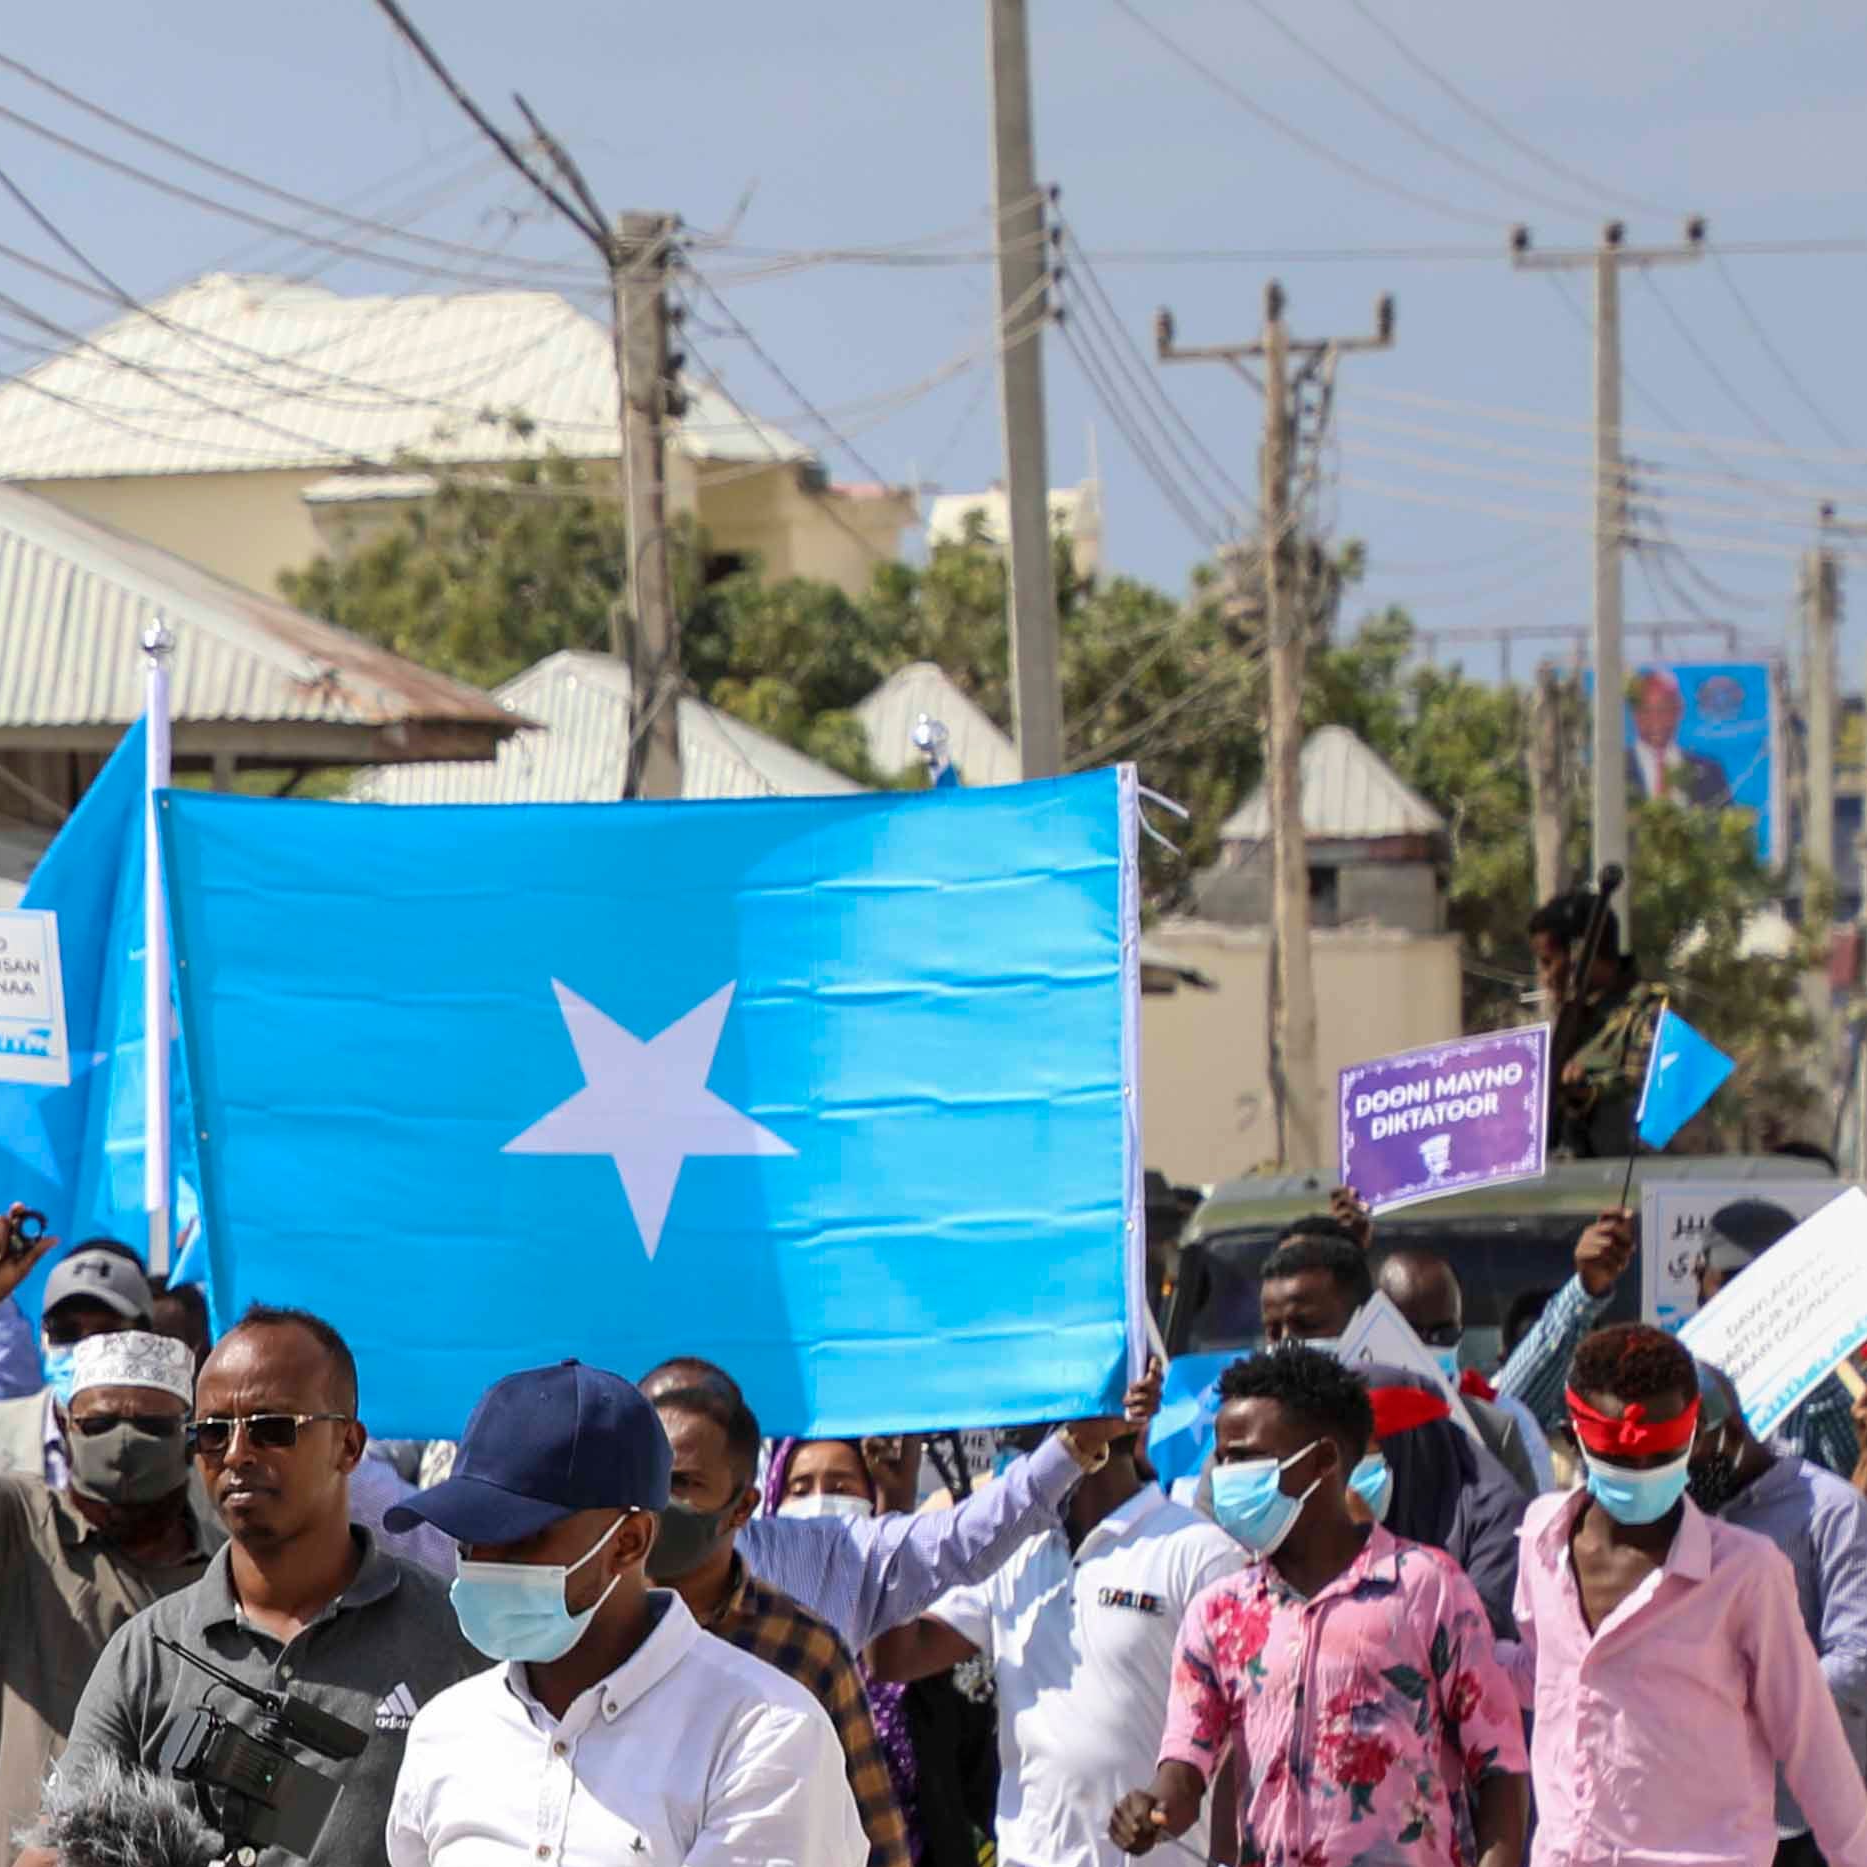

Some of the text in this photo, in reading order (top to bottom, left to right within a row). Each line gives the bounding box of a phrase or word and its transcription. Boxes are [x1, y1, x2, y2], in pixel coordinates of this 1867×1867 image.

[1355, 1061, 1524, 1119] DOONI MAYNO
[1371, 1091, 1500, 1141] DIKTATOOR
